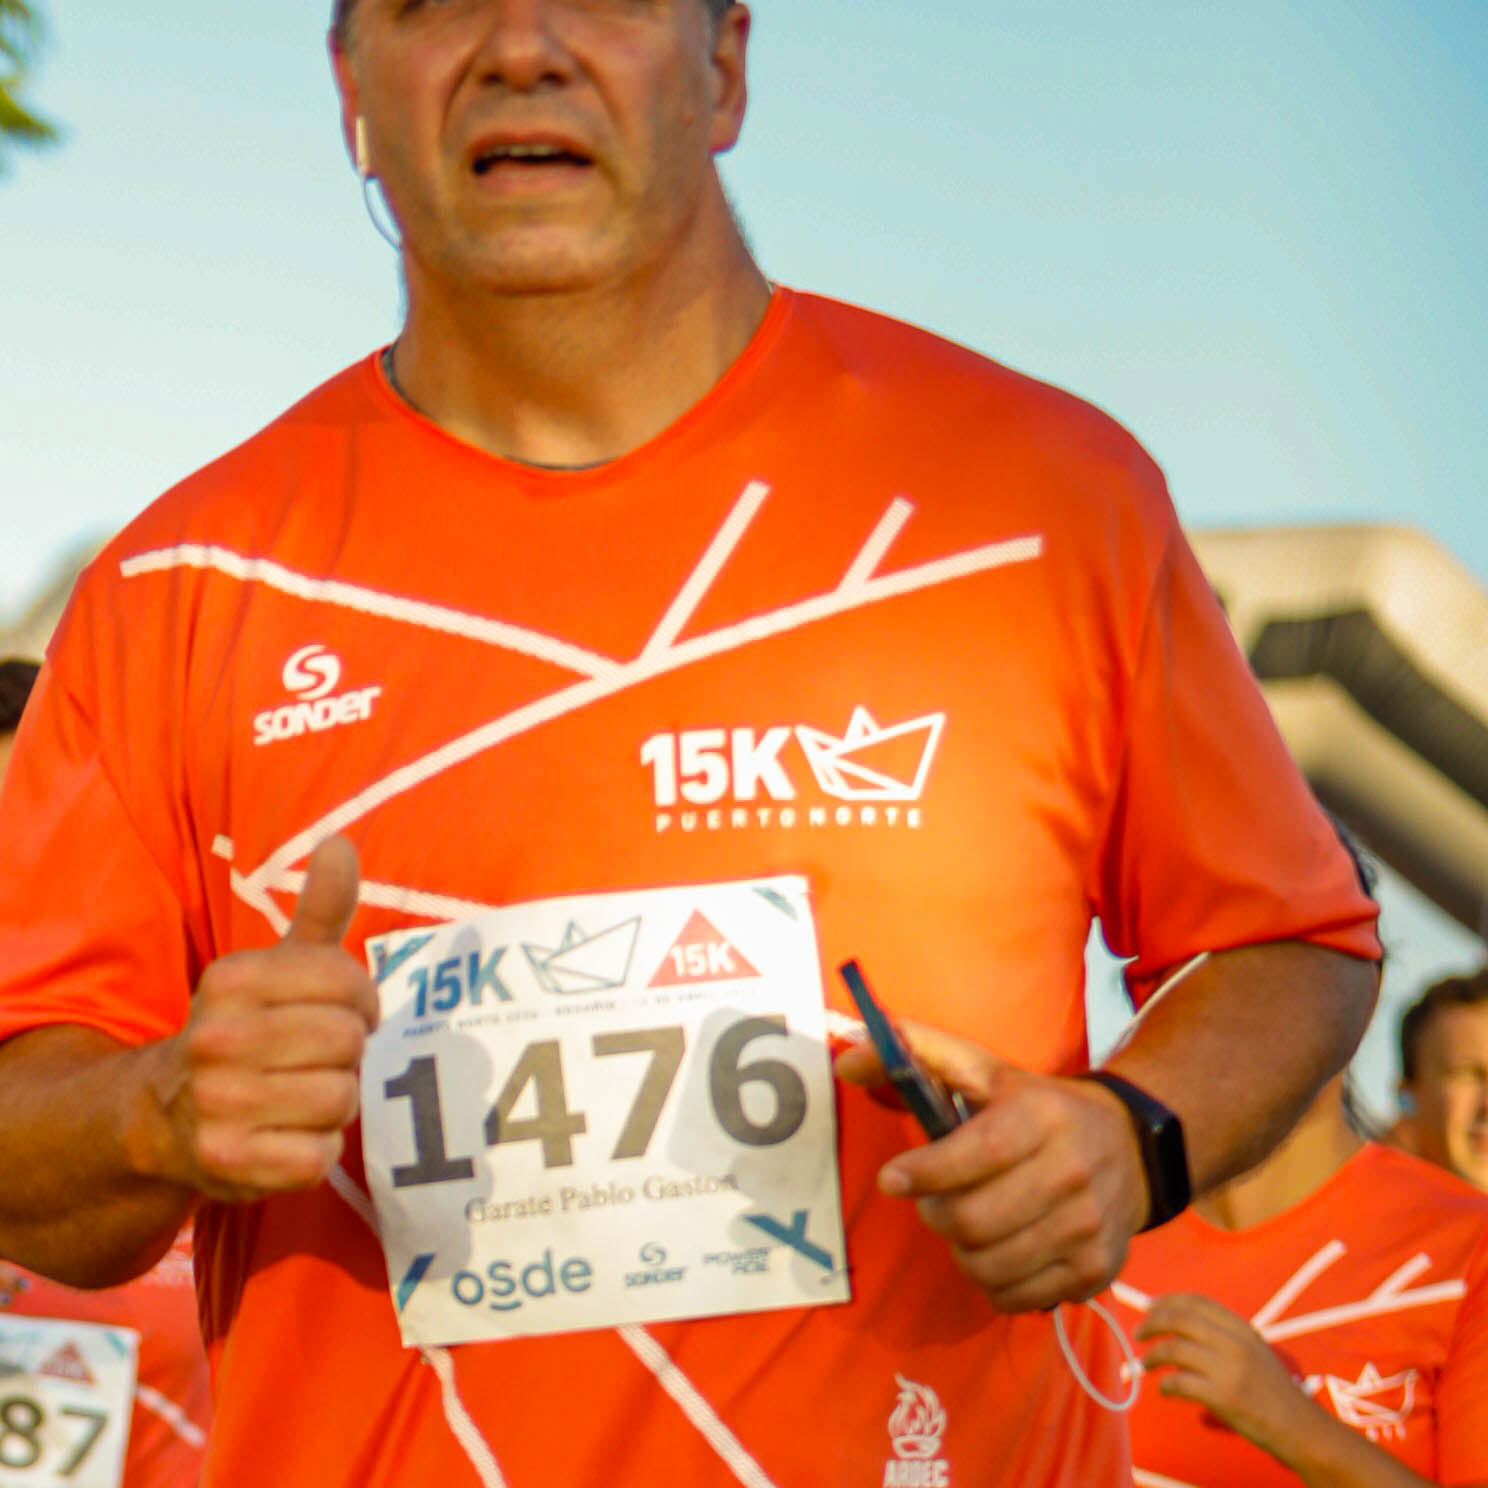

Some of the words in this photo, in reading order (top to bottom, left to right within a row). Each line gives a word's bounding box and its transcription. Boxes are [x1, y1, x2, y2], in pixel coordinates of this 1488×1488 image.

[639, 725, 797, 806] 15K
[655, 806, 797, 832] PUERTO
[808, 804, 922, 830] NORTE
[406, 944, 514, 1018] 15K
[670, 941, 736, 977] 15K
[383, 1013, 809, 1189] 1476
[559, 1180, 636, 1212] Pablo
[451, 1246, 593, 1309] osde
